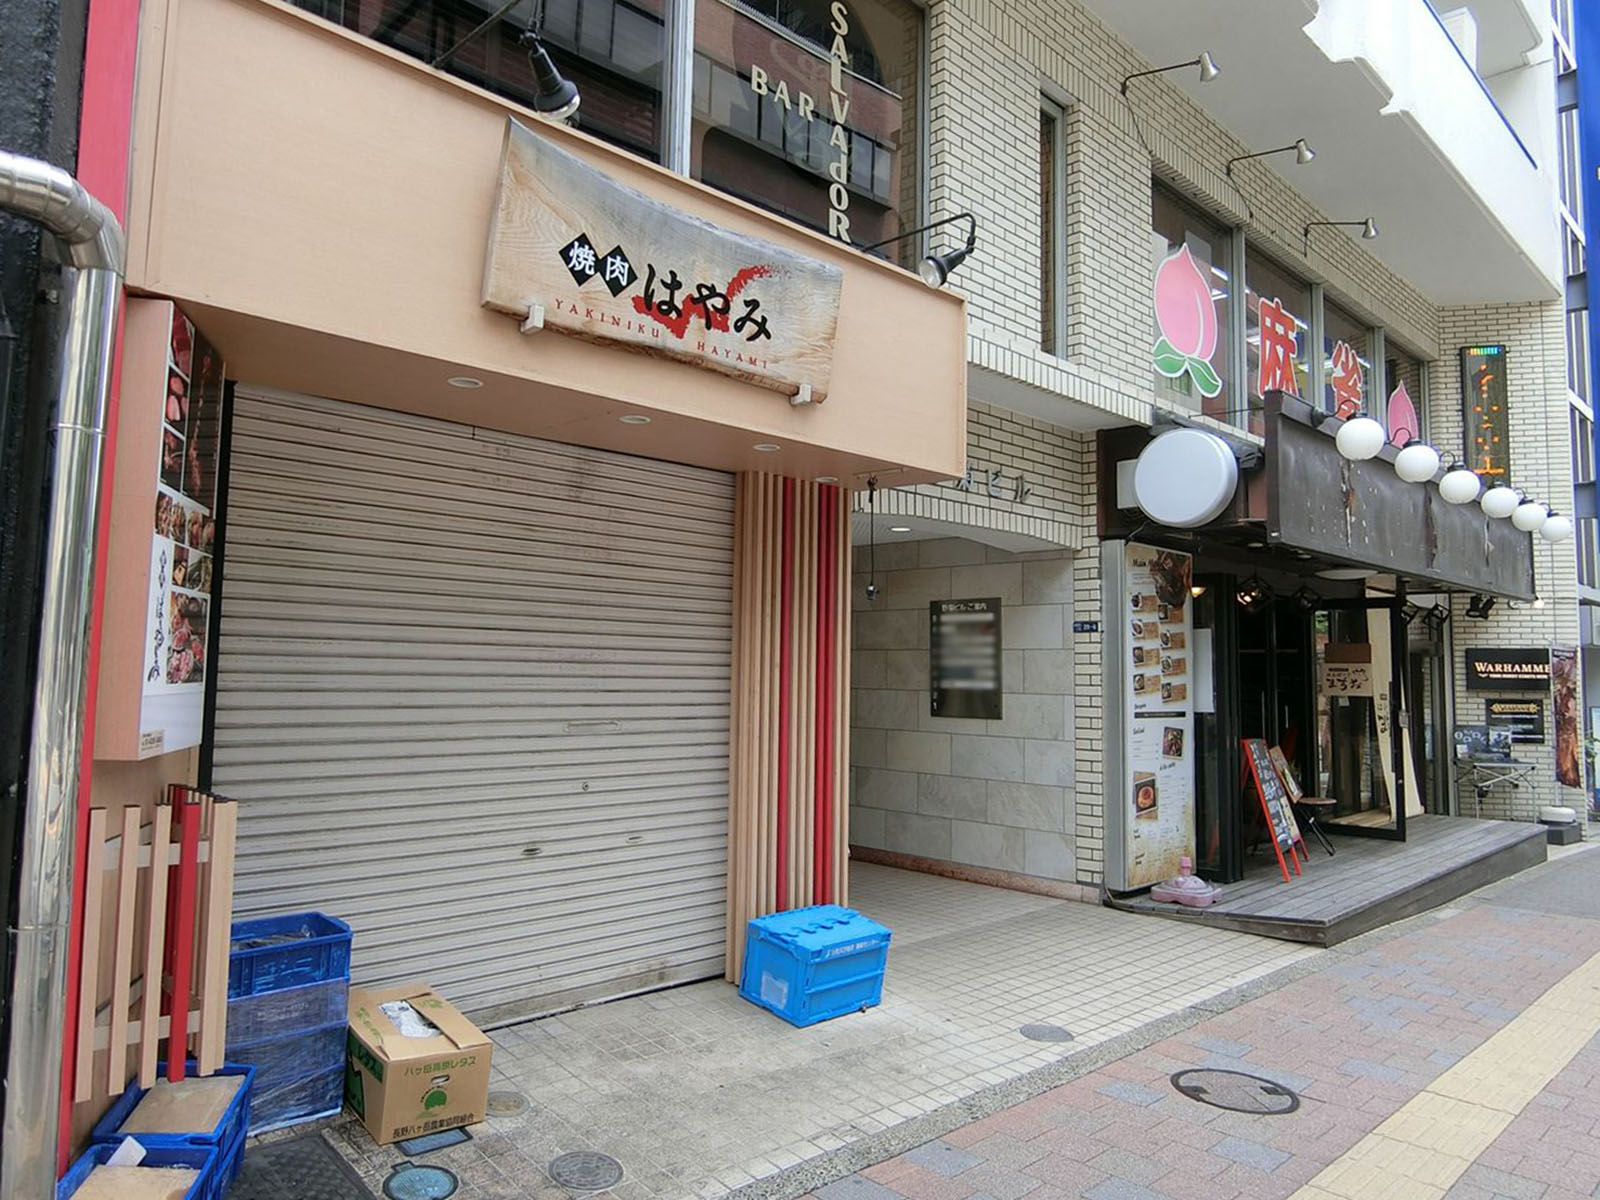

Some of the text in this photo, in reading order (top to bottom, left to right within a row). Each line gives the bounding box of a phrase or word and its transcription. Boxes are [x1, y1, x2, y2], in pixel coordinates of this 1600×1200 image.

[751, 64, 814, 122] BAR
[566, 240, 772, 342] 焼肉 はやみ
[555, 299, 769, 370] YAKINIKU HAYAMI
